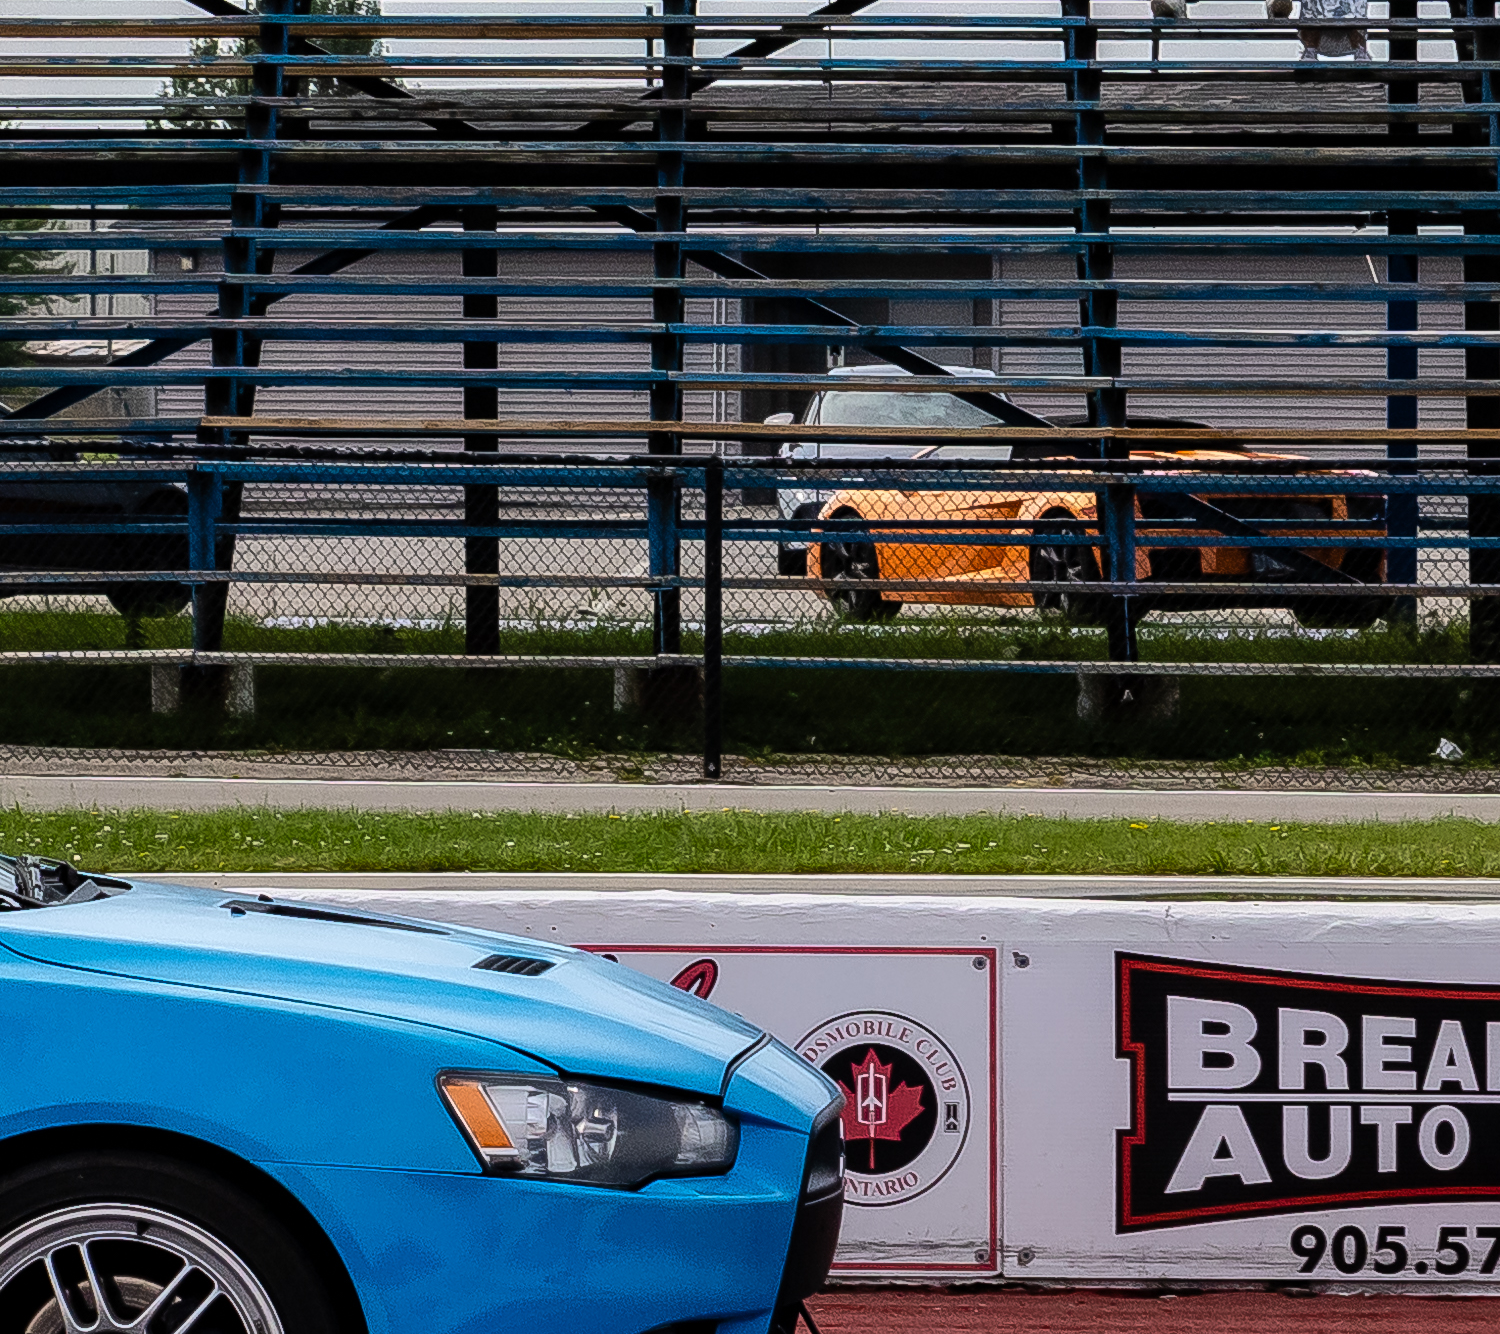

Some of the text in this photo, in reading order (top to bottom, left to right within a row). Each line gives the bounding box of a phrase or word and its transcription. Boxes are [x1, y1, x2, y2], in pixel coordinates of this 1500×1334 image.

[915, 1038, 958, 1092] CLUB
[1163, 1104, 1472, 1195] AUTO
[843, 1171, 919, 1198] NTARIO
